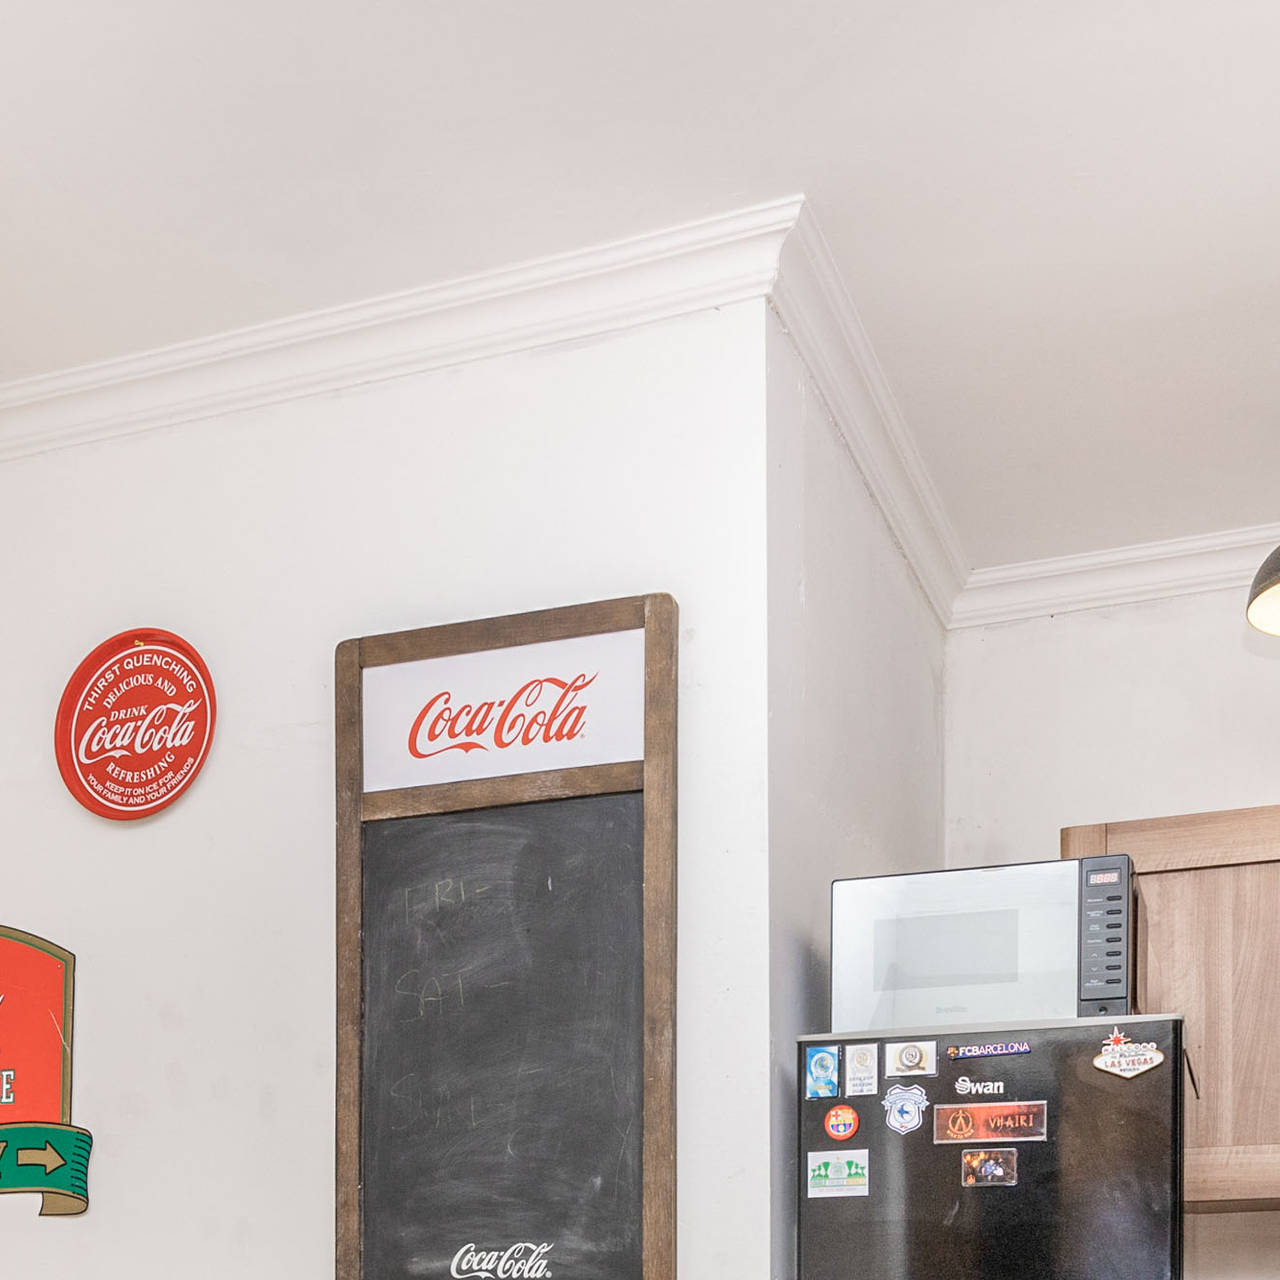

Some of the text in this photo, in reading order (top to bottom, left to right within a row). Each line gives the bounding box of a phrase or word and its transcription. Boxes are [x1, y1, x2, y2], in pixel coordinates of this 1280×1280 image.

[83, 654, 197, 711] THIRST QUENCHING
[103, 674, 177, 709] DELICIOUS AND
[110, 705, 149, 721] DRINK
[408, 671, 599, 759] Coca-Cola
[78, 698, 202, 764] Coca-Cola
[87, 757, 194, 805] YOUR FAMILY AND YOUR FRIENDS
[105, 751, 175, 783] REFRESHING
[105, 780, 125, 793] KEEP
[132, 787, 145, 795] ON
[145, 782, 159, 793] ICE
[159, 771, 175, 786] FOR
[1105, 1056, 1154, 1069] LAS VEGAS
[954, 1076, 1005, 1094] Swan
[450, 1243, 554, 1279] Coca-Cola
